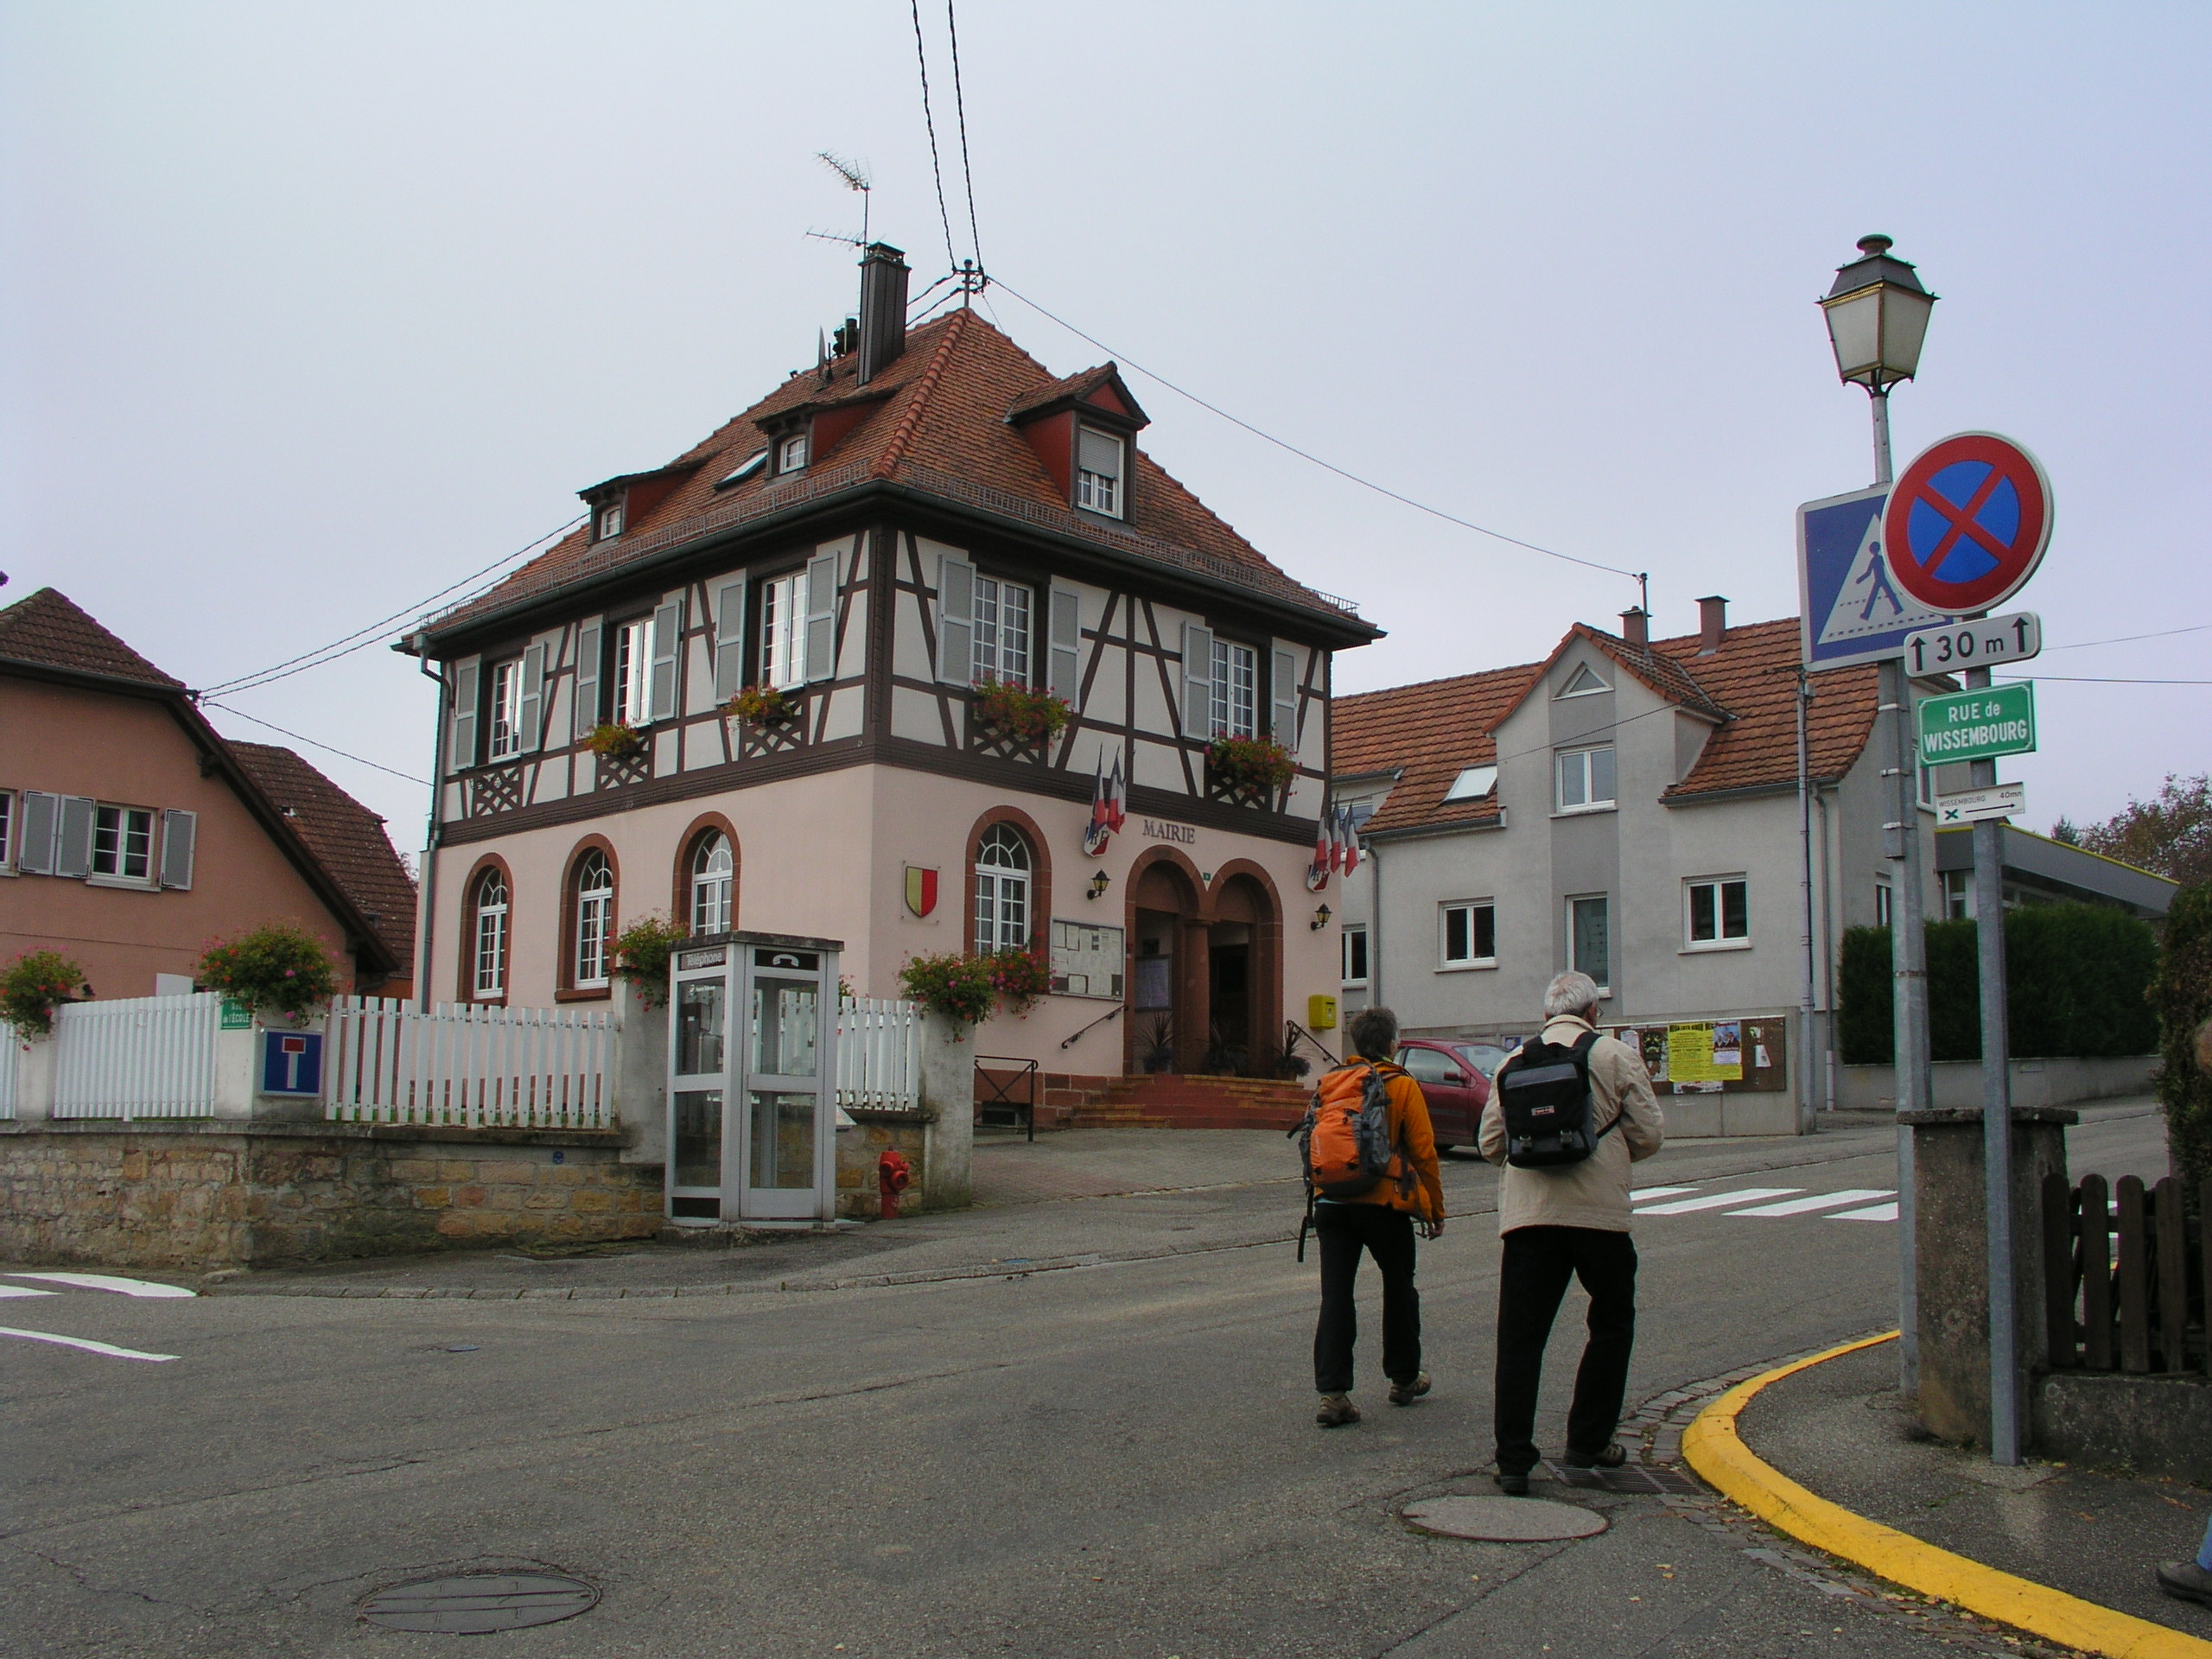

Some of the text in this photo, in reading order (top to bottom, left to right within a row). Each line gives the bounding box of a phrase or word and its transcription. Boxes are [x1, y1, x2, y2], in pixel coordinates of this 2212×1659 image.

[1936, 631, 2005, 662] 30 m
[1948, 701, 2001, 723] RUE de
[1923, 719, 2028, 753] WISSEMBOURG
[1939, 791, 2022, 808] WISSEMBOURG 40mn
[1142, 819, 1196, 844] MAIRIE
